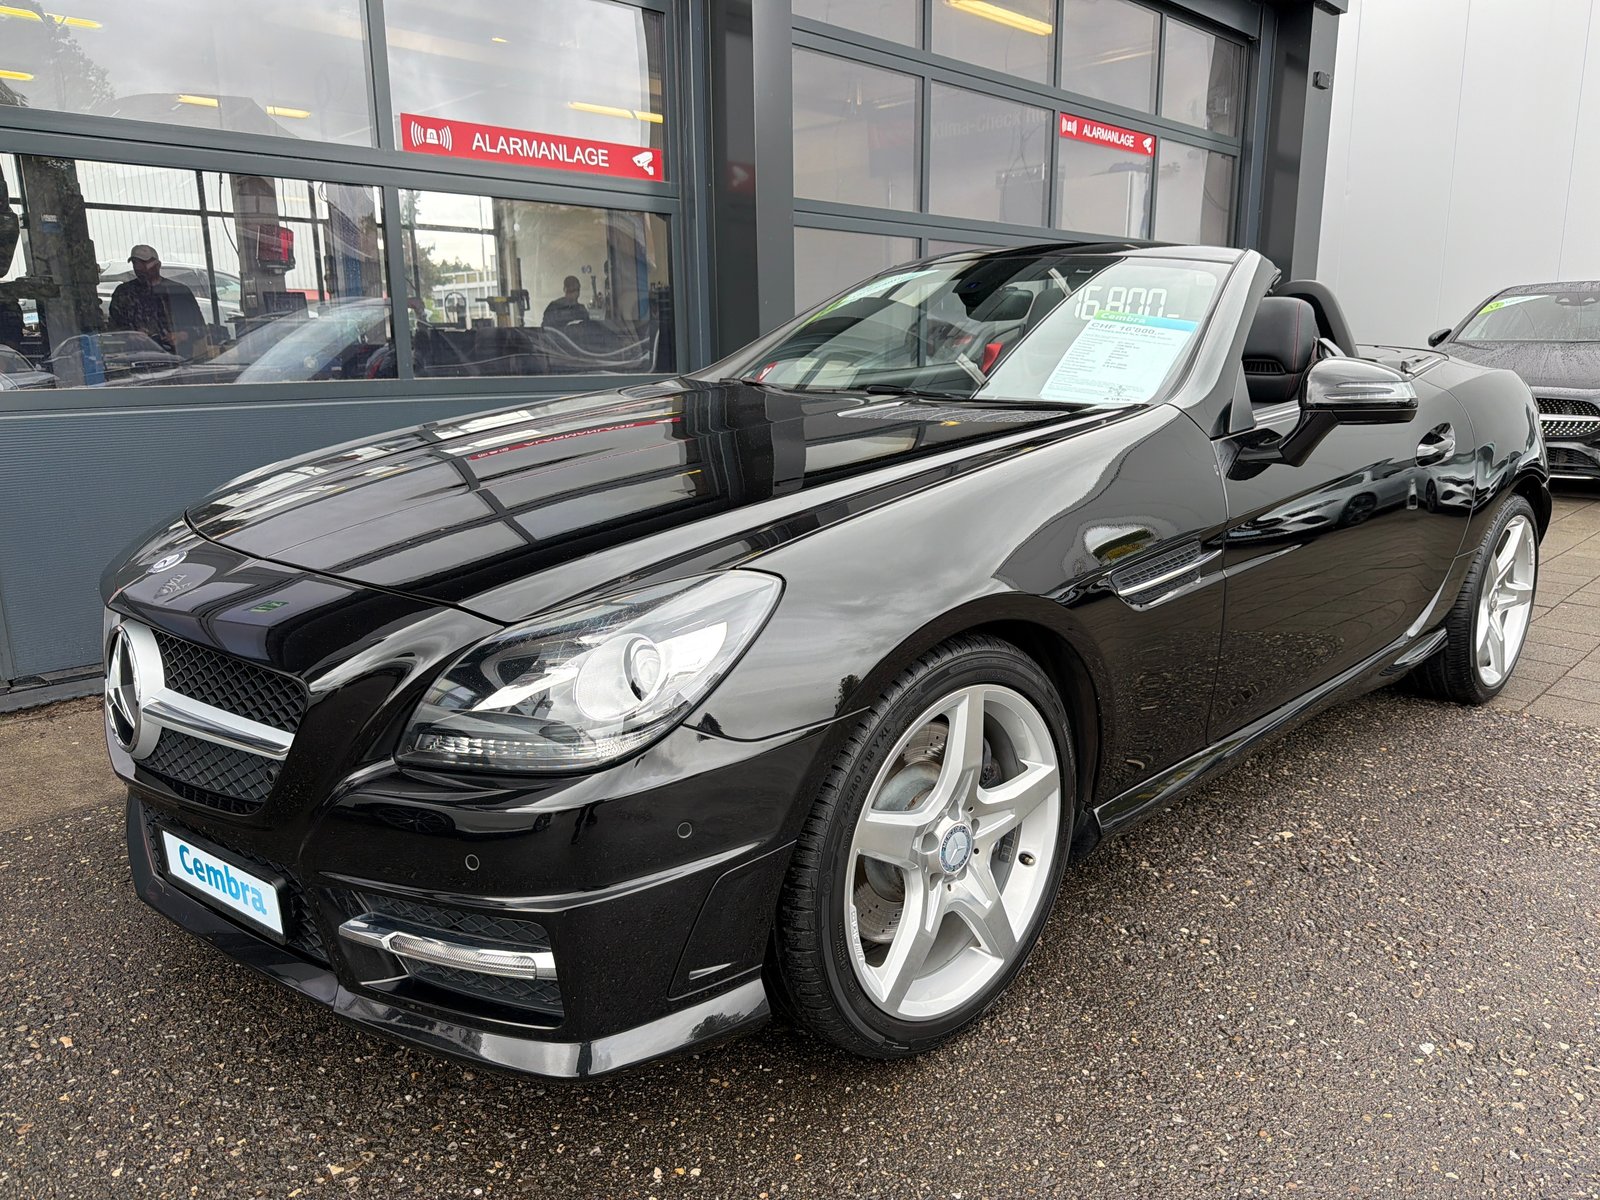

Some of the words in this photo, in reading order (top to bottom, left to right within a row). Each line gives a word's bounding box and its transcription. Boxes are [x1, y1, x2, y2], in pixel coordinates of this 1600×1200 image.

[472, 132, 609, 167] ALARMANLAGE
[1083, 124, 1134, 147] ALARMANLAGE
[179, 844, 267, 916] Cembra
